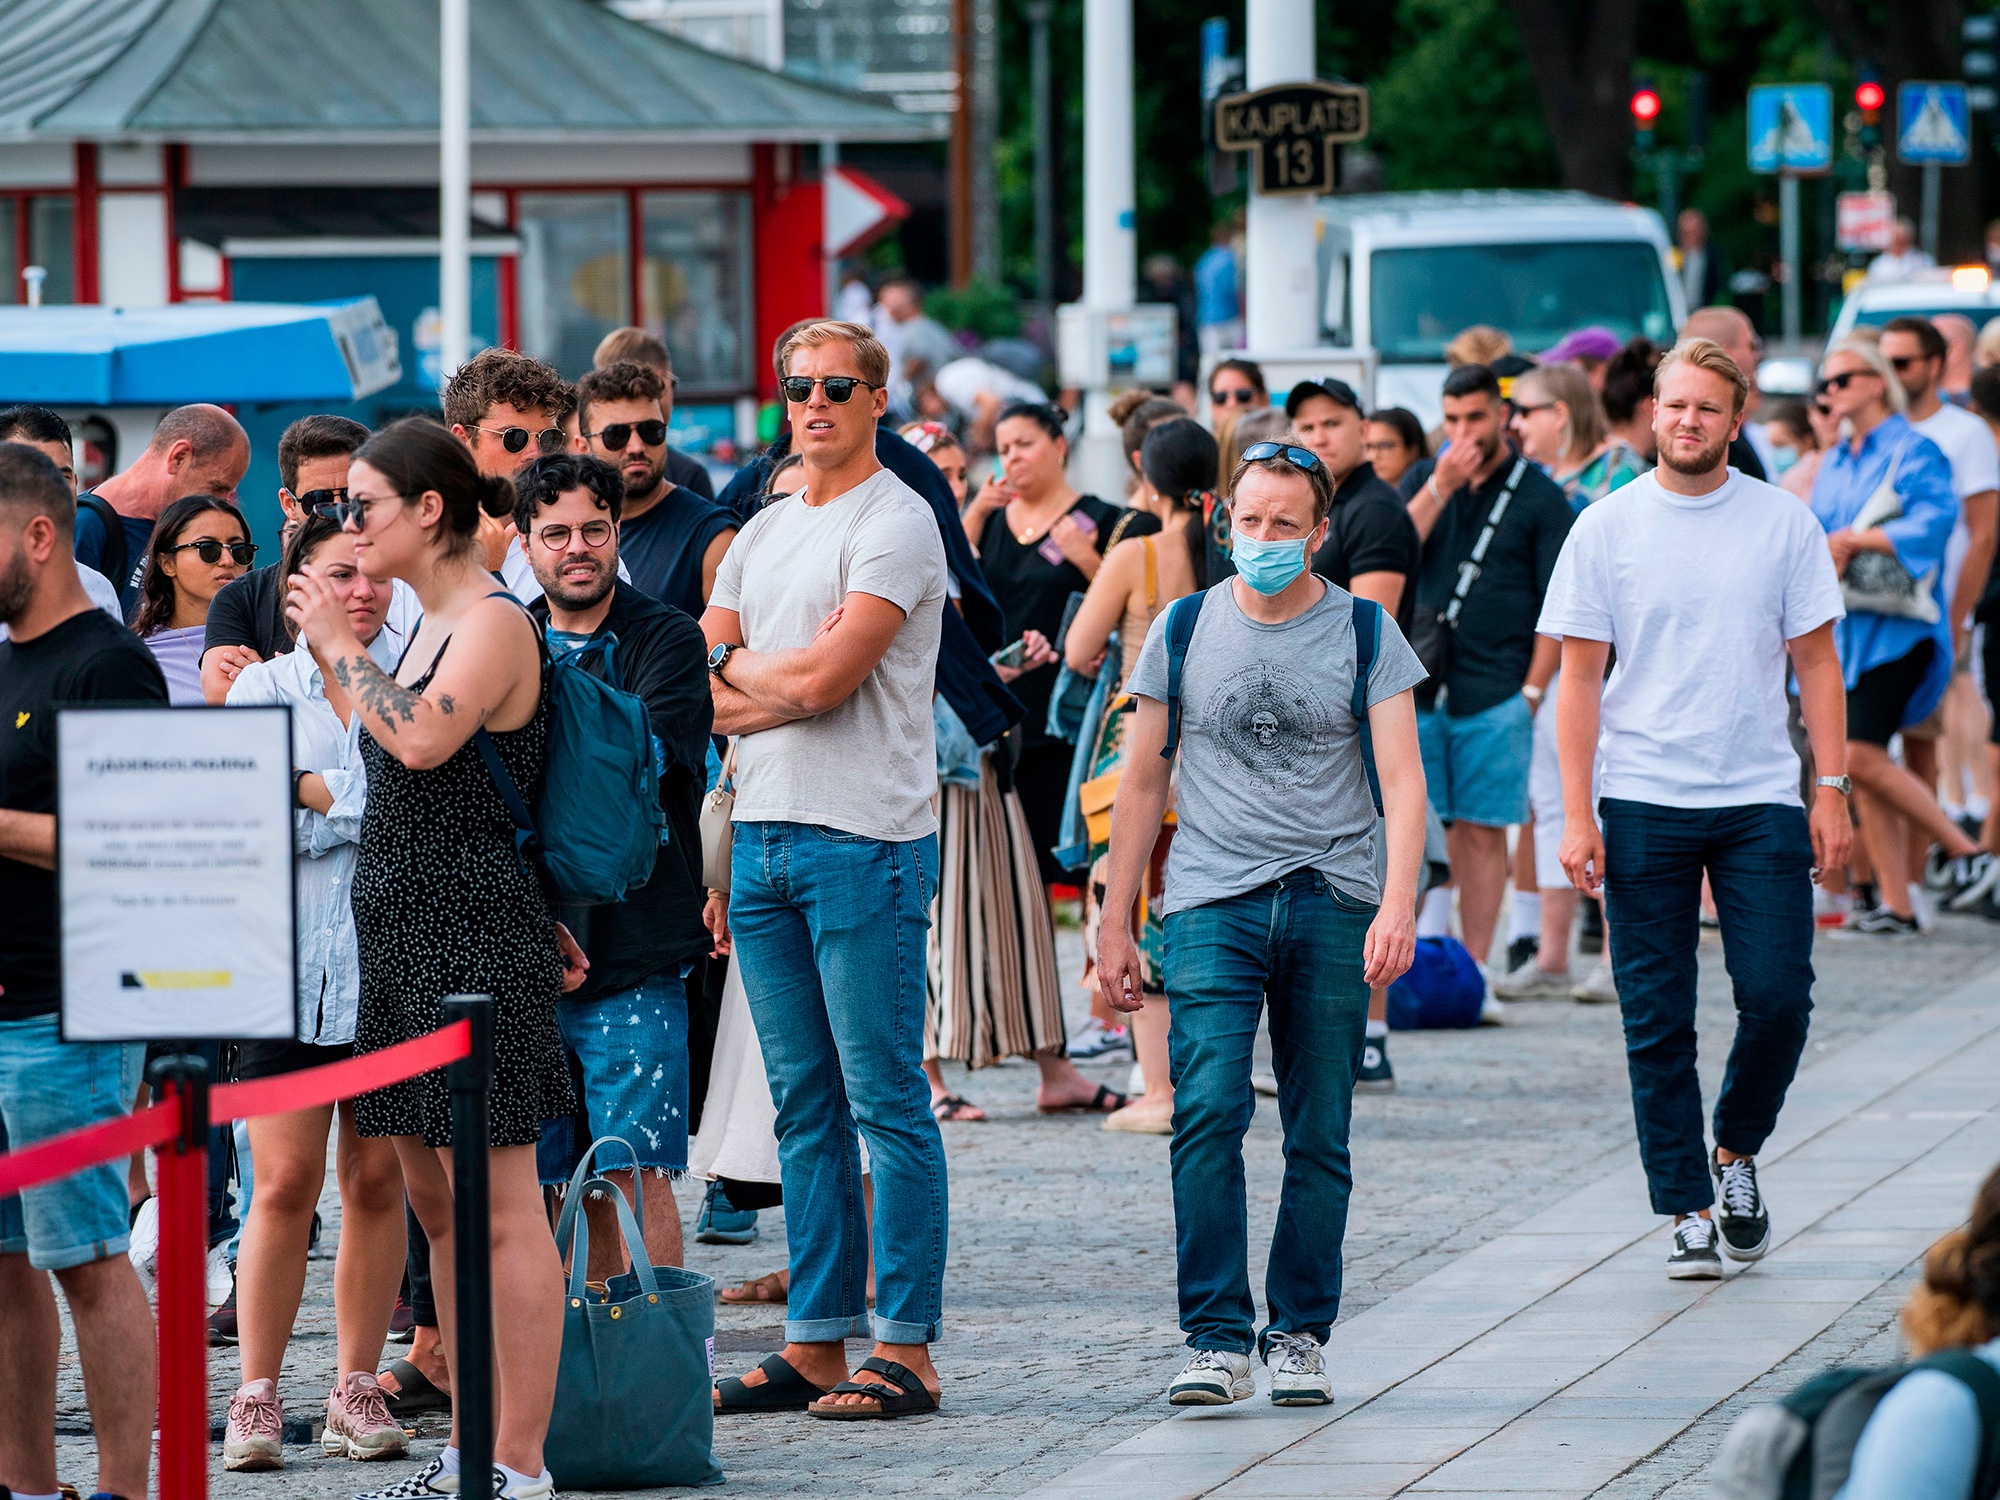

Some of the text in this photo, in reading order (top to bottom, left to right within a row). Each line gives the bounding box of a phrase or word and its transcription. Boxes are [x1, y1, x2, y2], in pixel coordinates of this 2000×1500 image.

[1226, 97, 1358, 138] KAJPLATS
[1274, 139, 1314, 185] 13
[130, 567, 143, 588] NEW
